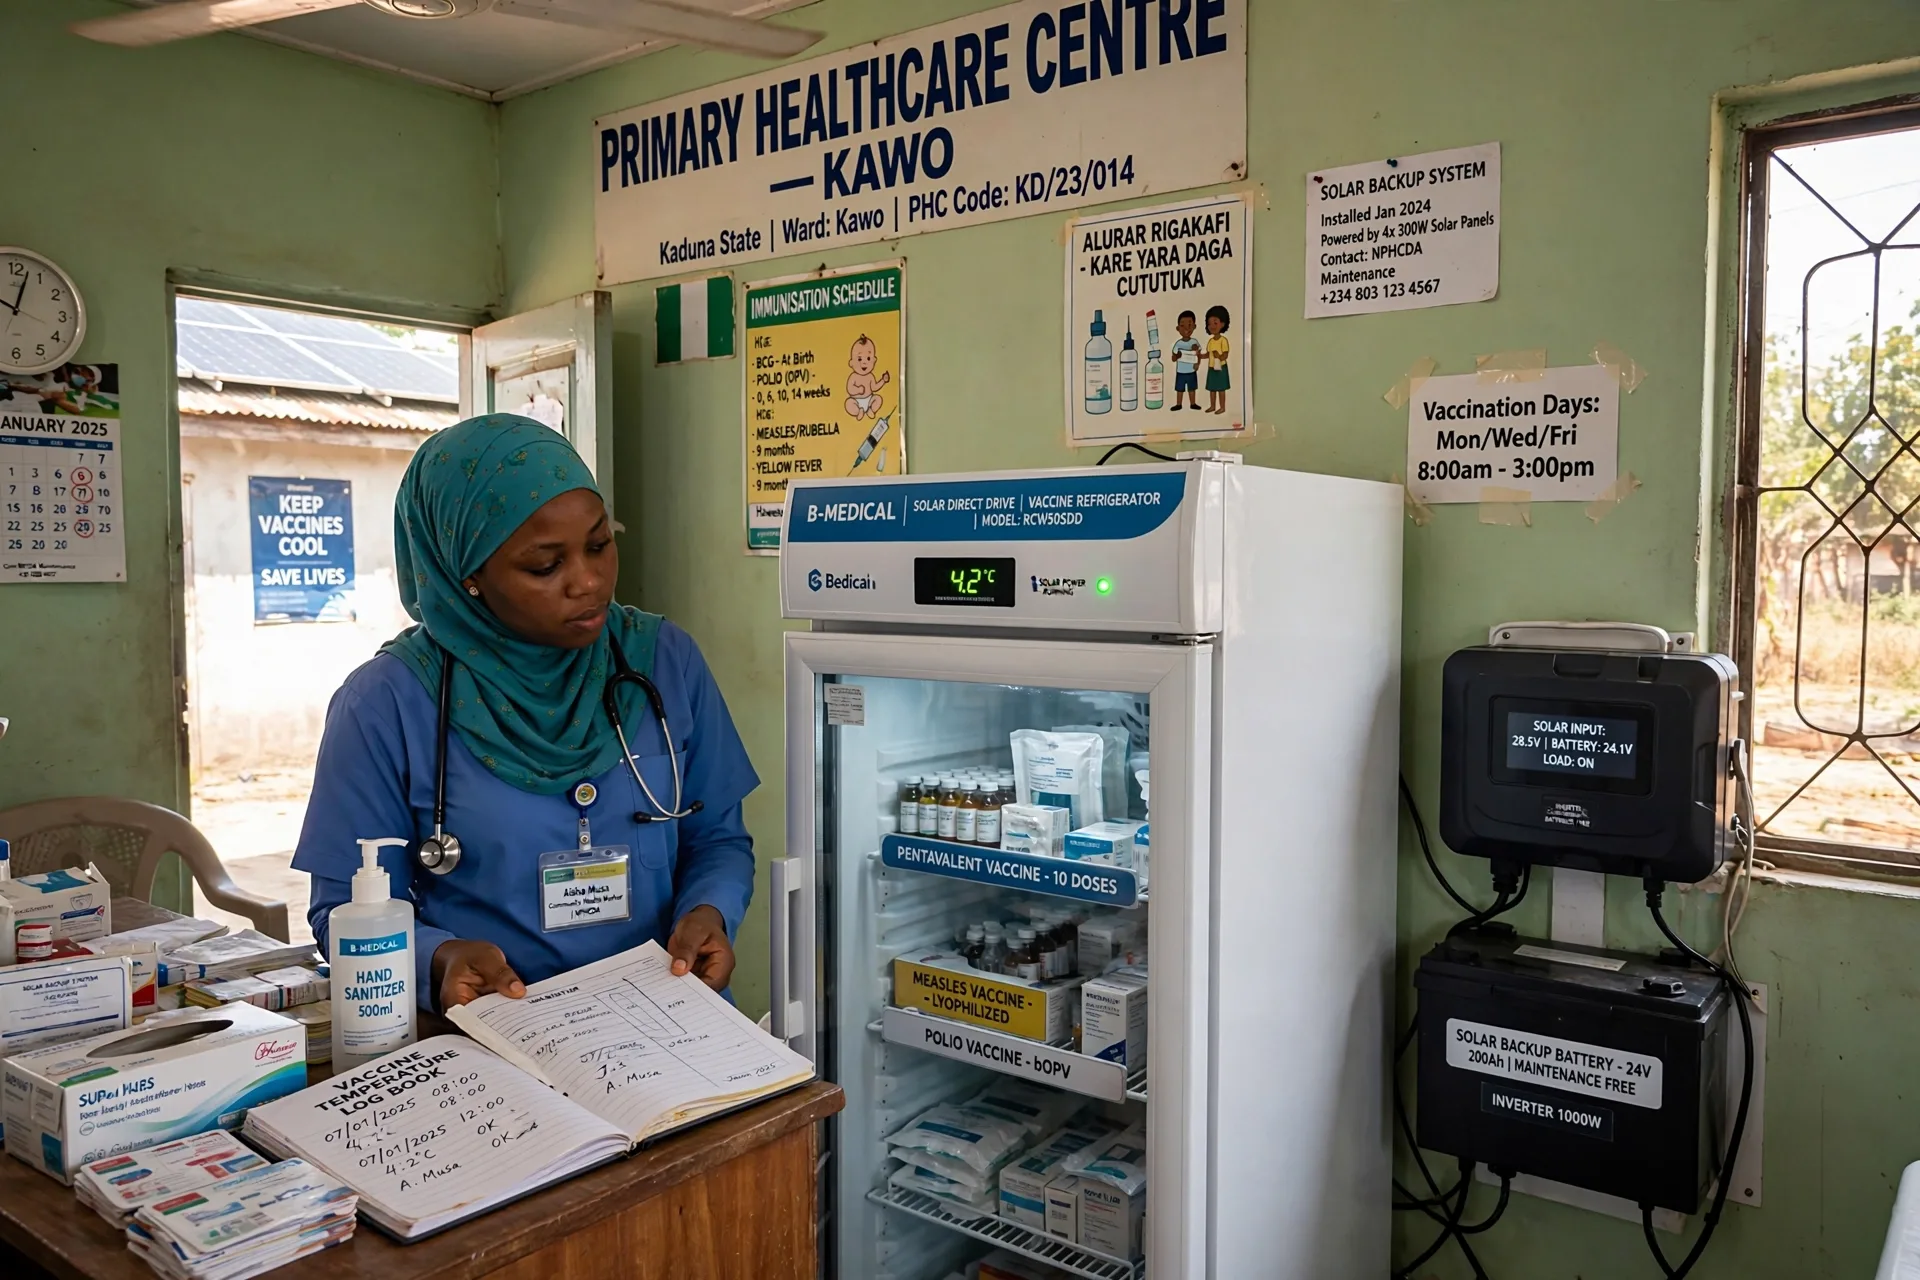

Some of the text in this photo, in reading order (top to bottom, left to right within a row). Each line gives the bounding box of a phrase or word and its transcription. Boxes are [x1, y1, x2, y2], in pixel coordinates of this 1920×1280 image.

[601, 0, 1227, 192] PRIMARY HEALTHCARE CENTRE
[824, 127, 954, 200] KAWO
[1320, 161, 1486, 201] SOLAR BACKUP SYSTEM
[660, 155, 1134, 265] Kaduna State Ward: Kawo PHC Code: KD/23/014
[1321, 199, 1431, 227] Installed Jan 2024
[1082, 211, 1230, 252] ALURAR RIGAKAFI
[1321, 211, 1494, 247] Powered by 4x 300W Solar Panels
[1090, 237, 1232, 276] KARE YARA DAGA
[1321, 241, 1423, 266] Contact: NPHCDA
[8, 262, 24, 277] 12
[37, 273, 42, 284] 1
[1321, 267, 1396, 285] Maintenance
[1117, 267, 1205, 297] CUTUTUKA
[1321, 278, 1440, 304] +234 803 123 4567
[51, 288, 60, 301] 2
[751, 276, 896, 320] IMMUNISATION SCHEDULE
[58, 311, 67, 323] 3
[50, 330, 60, 343] 4
[11, 347, 21, 360] 6
[35, 344, 45, 356] 5
[756, 355, 774, 369] BCG
[793, 350, 814, 365] Birth
[757, 369, 809, 386] POLIO (OPV)
[777, 389, 789, 403] 10,
[791, 388, 802, 400] 14
[804, 384, 830, 399] weeks
[1423, 394, 1600, 421] Vaccination Days:
[0, 416, 108, 436] ANUARY 2025
[757, 422, 840, 440] MEASLES/RUBELLA
[1436, 424, 1577, 451] Mon/Wed/Fri
[98, 453, 105, 464] 7
[756, 442, 795, 457] 9 months
[9, 467, 14, 476] 1
[32, 468, 38, 478] 3
[54, 469, 62, 479] 6
[756, 459, 823, 474] YELLOW FEVER
[1417, 457, 1595, 482] 8:00am 3:00pm
[9, 485, 16, 495] 7
[53, 486, 66, 496] 17
[756, 479, 762, 491] 9
[279, 494, 324, 514] KEEP
[807, 492, 1161, 522] B-MEDICAL SOLAR DIRECT DRIVE VACCINE REFRIGERATOR
[7, 521, 21, 531] 22
[30, 521, 44, 531] 25
[53, 522, 67, 532] 25
[99, 523, 111, 533] 25
[258, 515, 344, 535] VACCINES
[981, 512, 1083, 527] MODEL: RCW50SDD
[278, 536, 328, 556] COOL
[261, 568, 346, 585] SAVE LIVES
[1533, 720, 1606, 737] SOLAR INPUT:
[1511, 735, 1633, 755] 28.5V BATTERY: 24.1V
[1543, 754, 1595, 769] LOAD: ON
[897, 846, 1117, 895] PENTAVALENT VACCINE 10 DOSES
[356, 968, 392, 984] HAND
[344, 980, 405, 1001] SANITIZER
[912, 971, 1025, 1009] MEASLES VACCINE
[359, 1001, 393, 1017] 500ml
[932, 993, 1010, 1024] LYOPHILIZED
[925, 1028, 1071, 1079] POLIO VACCINE bOPV
[1456, 1029, 1652, 1078] SOLAR BACKUP BATTERY 24V
[314, 1049, 460, 1111] TEMPERATURE
[332, 1051, 425, 1091] VACCINE
[1468, 1049, 1636, 1096] 200Ah MAINTENANCE FREE
[339, 1067, 446, 1116] LOG BOOK
[432, 1072, 478, 1097] 08:00
[440, 1083, 486, 1109] 08:00
[460, 1096, 504, 1122] 12:00
[1492, 1093, 1602, 1129] INVERTER 1000W
[477, 1119, 499, 1135] OK
[423, 1162, 462, 1182] Musa
[491, 1131, 514, 1148] OK
